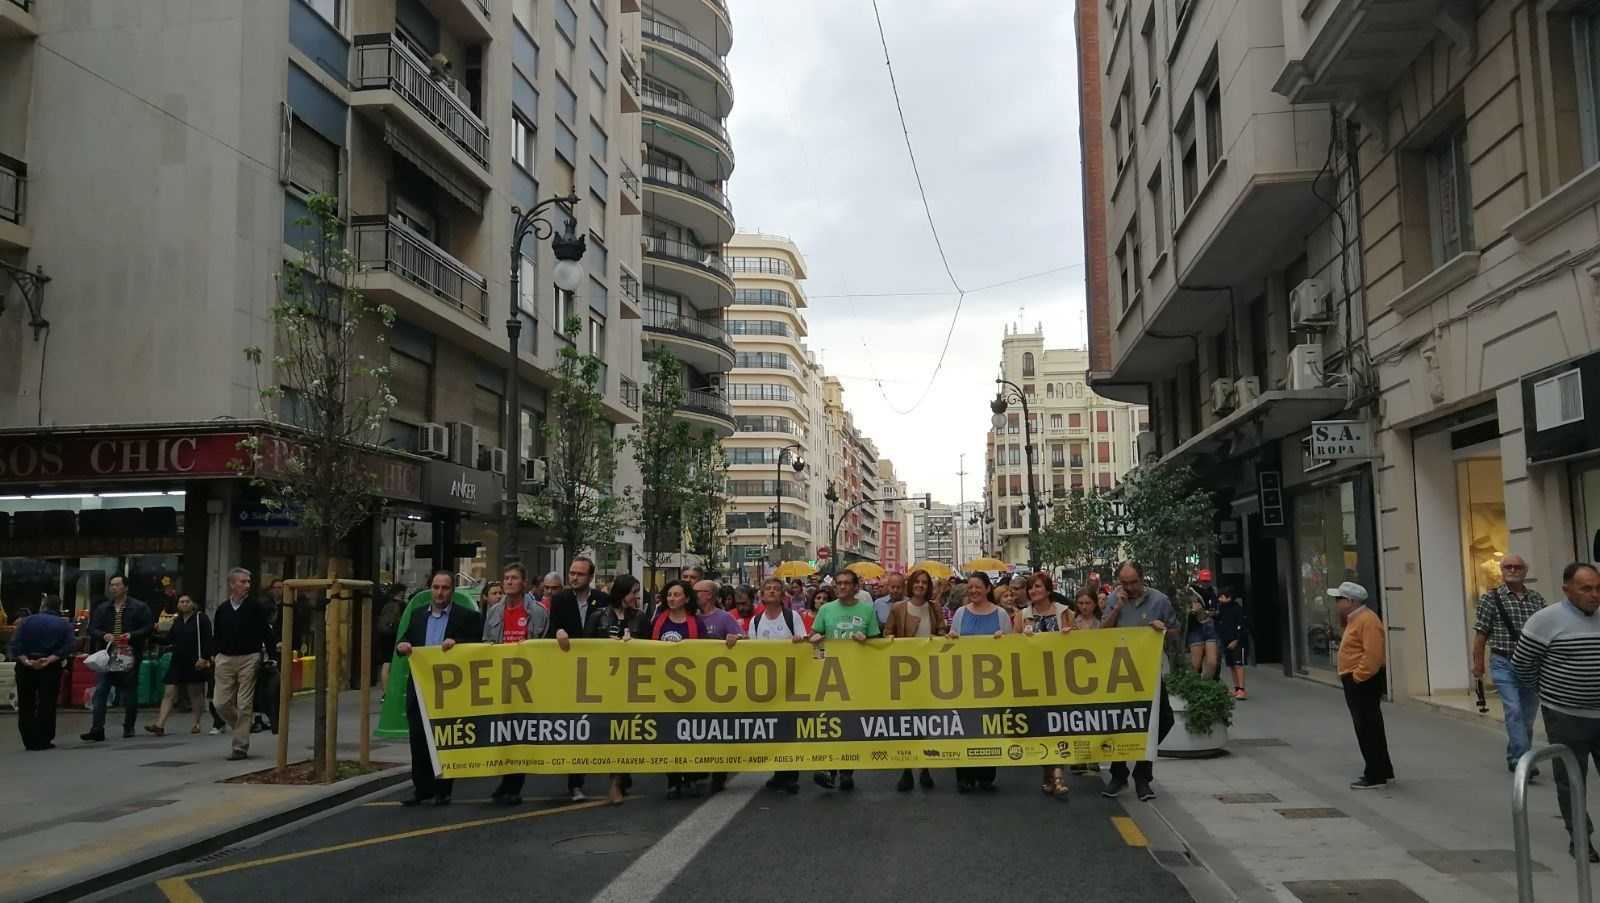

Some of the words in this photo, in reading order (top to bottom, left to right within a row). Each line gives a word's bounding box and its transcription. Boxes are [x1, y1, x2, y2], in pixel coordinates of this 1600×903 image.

[1316, 426, 1360, 441] S.A.
[0, 441, 63, 477] OS
[90, 437, 196, 473] CHIC
[1317, 446, 1355, 455] ROPA
[433, 656, 534, 710] PER
[575, 656, 850, 703] L'ESCOLA
[889, 643, 1145, 701] PÚBLICA
[433, 721, 477, 747] MÉS
[489, 714, 591, 743] INVERSIÓ
[609, 714, 658, 741] MÉS
[676, 717, 779, 741] QUALITAT
[795, 713, 842, 739] MÉS
[859, 710, 965, 738] VALENCIÀ
[981, 710, 1030, 736] MÉS
[1047, 707, 1148, 734] DIGNITAT
[694, 756, 724, 765] CAMPUS
